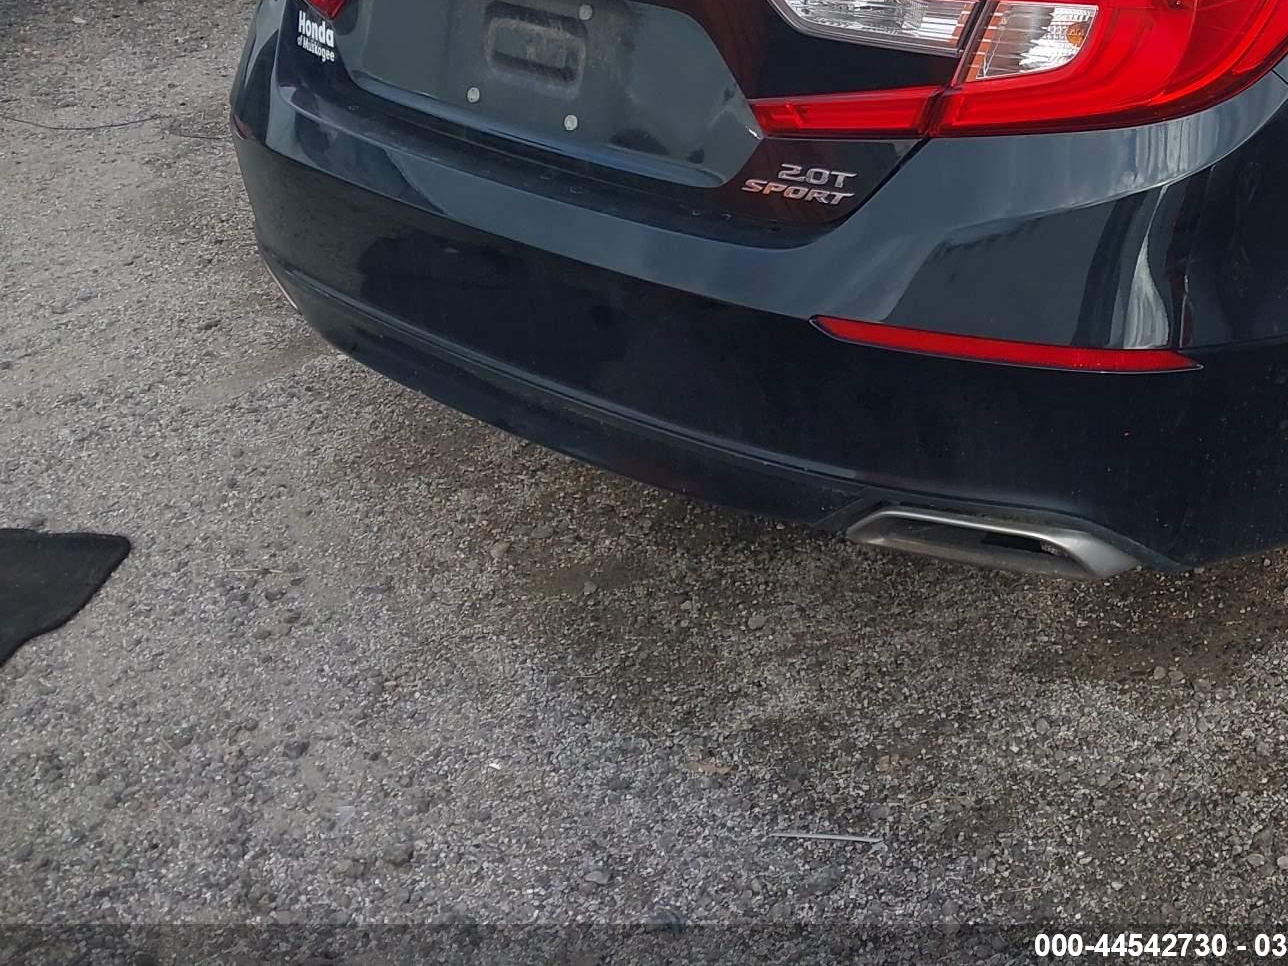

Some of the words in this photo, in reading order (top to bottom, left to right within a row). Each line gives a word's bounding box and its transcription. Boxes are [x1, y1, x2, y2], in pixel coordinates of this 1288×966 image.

[298, 9, 335, 48] Honda
[302, 36, 335, 62] Muskogee
[741, 178, 856, 205] SPORT
